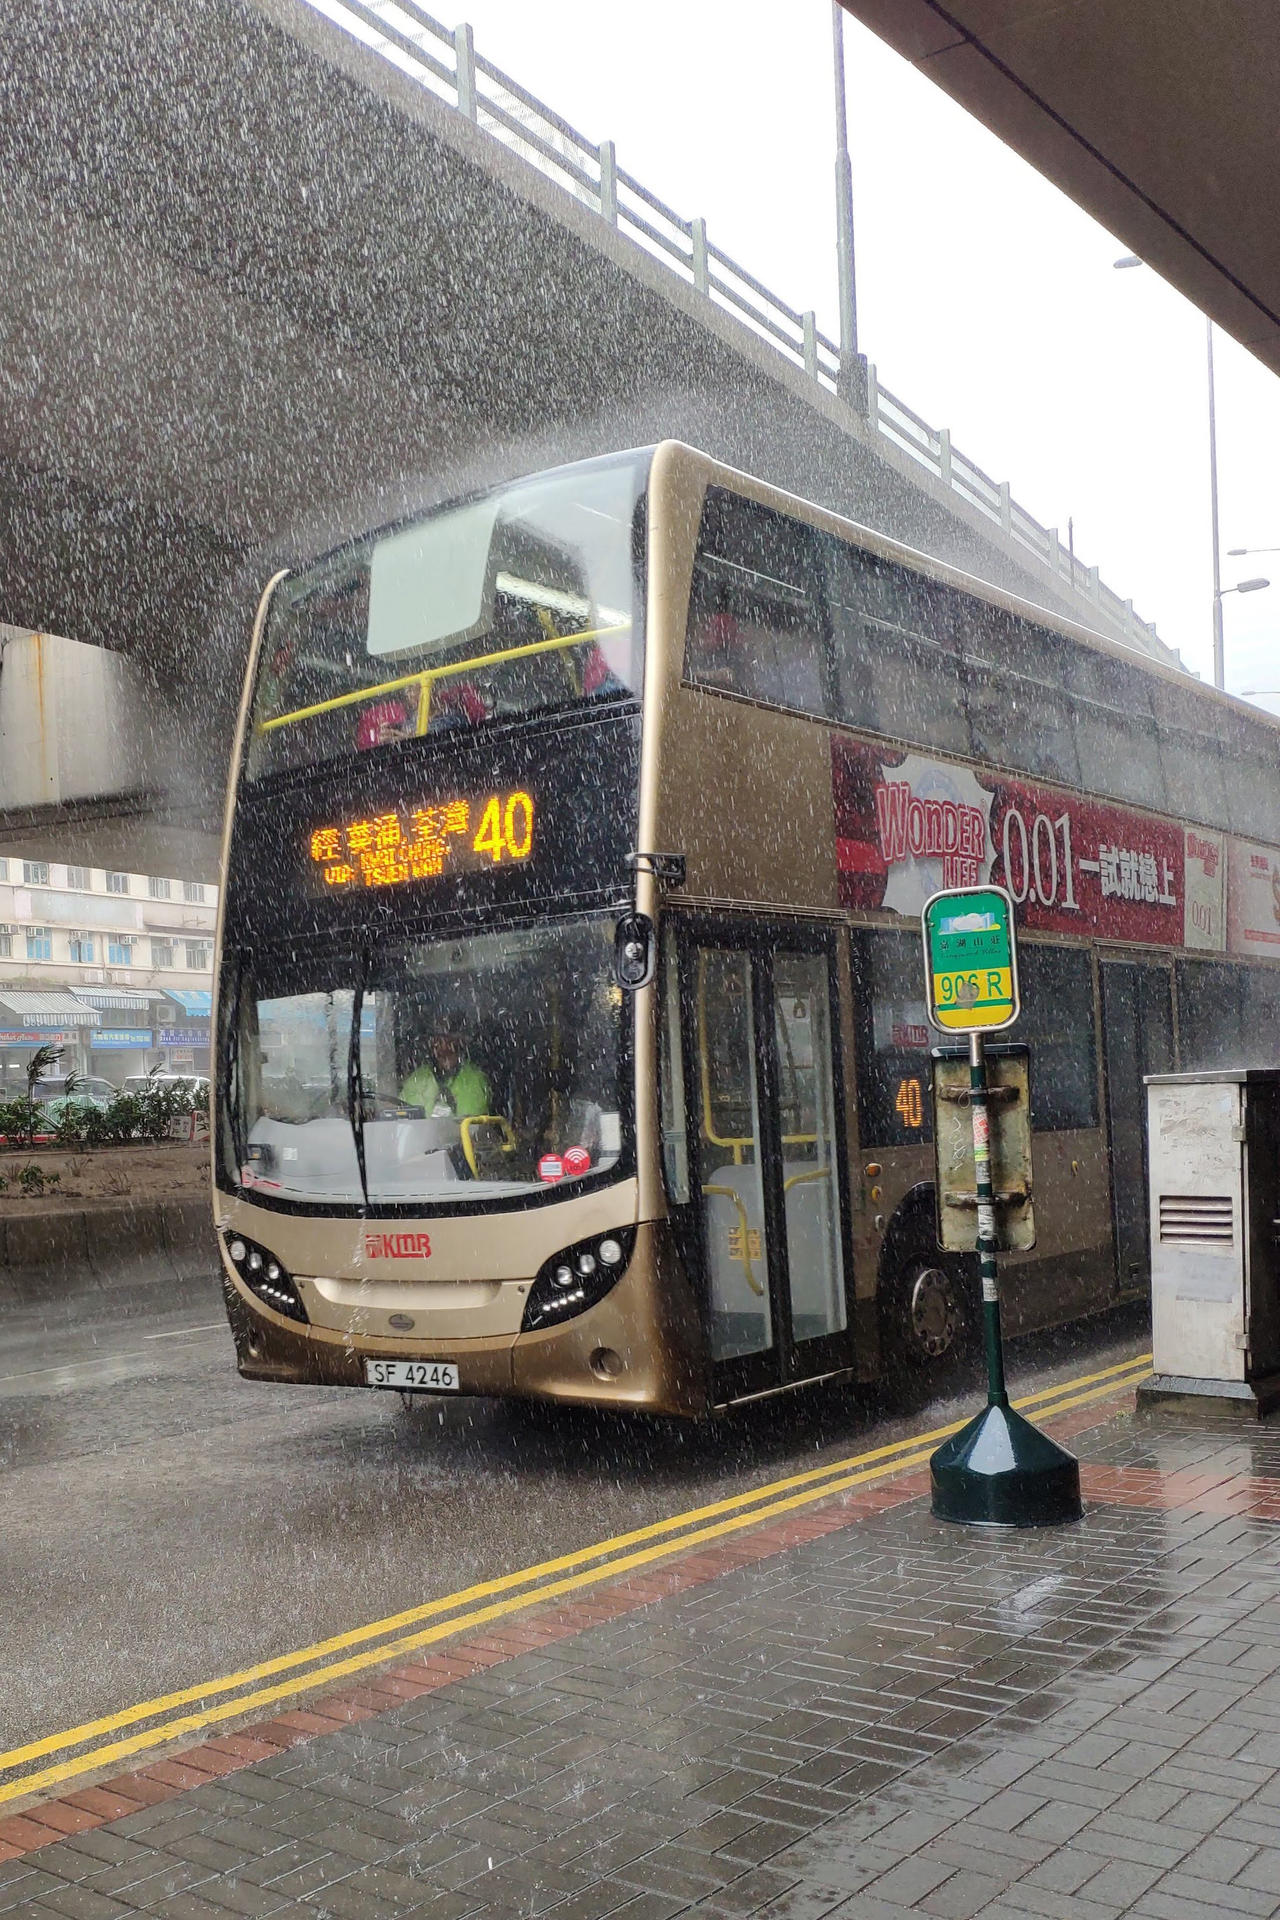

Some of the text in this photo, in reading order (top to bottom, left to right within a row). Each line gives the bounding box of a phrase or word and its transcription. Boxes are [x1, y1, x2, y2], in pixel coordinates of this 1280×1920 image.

[473, 791, 534, 862] 40
[1003, 809, 1080, 909] 0.01
[987, 971, 1004, 996] R
[896, 1079, 922, 1127] 40
[383, 1233, 432, 1258] KMB
[374, 1364, 453, 1386] SF 4246
